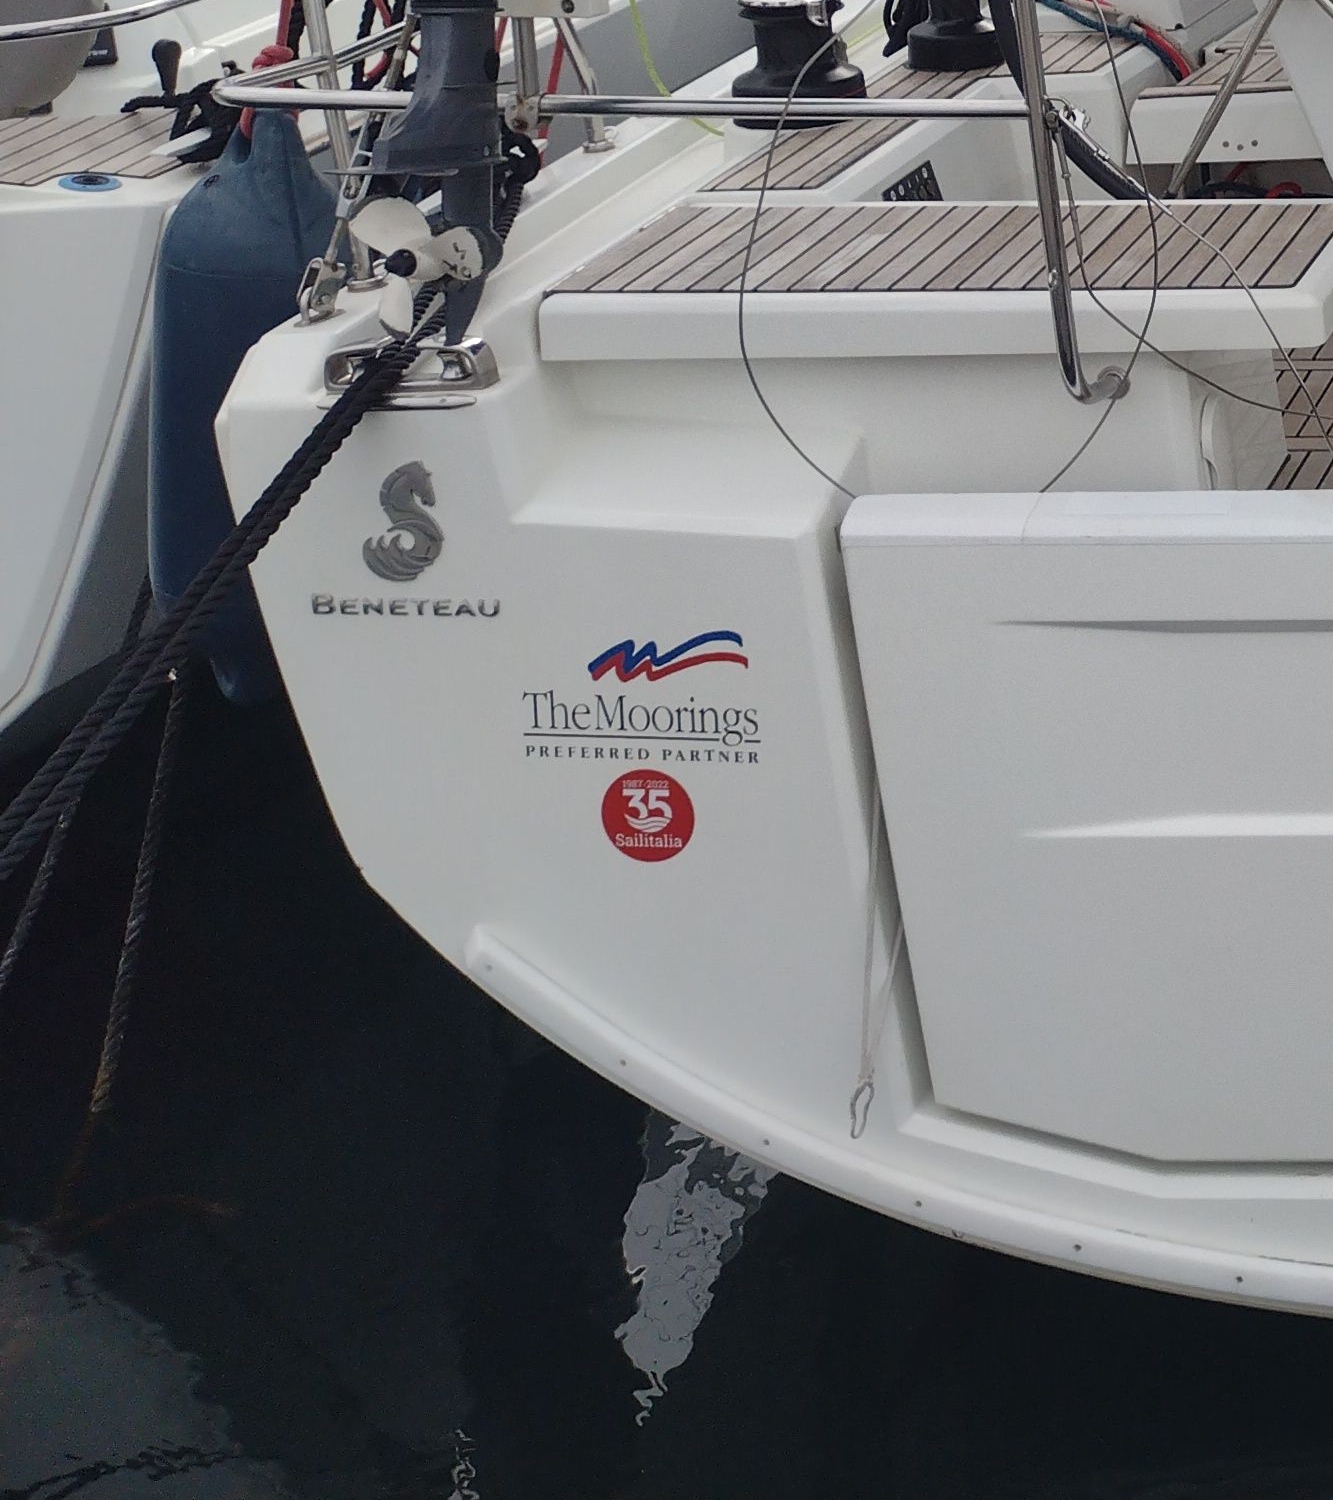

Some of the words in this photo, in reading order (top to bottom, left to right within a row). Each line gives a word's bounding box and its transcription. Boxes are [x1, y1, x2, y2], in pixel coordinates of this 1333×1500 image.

[311, 592, 501, 618] BENETEAU
[526, 744, 651, 760] PREFERRED
[662, 748, 760, 764] PARTNER
[622, 788, 673, 820] 35
[615, 833, 683, 848] Sailitalia
